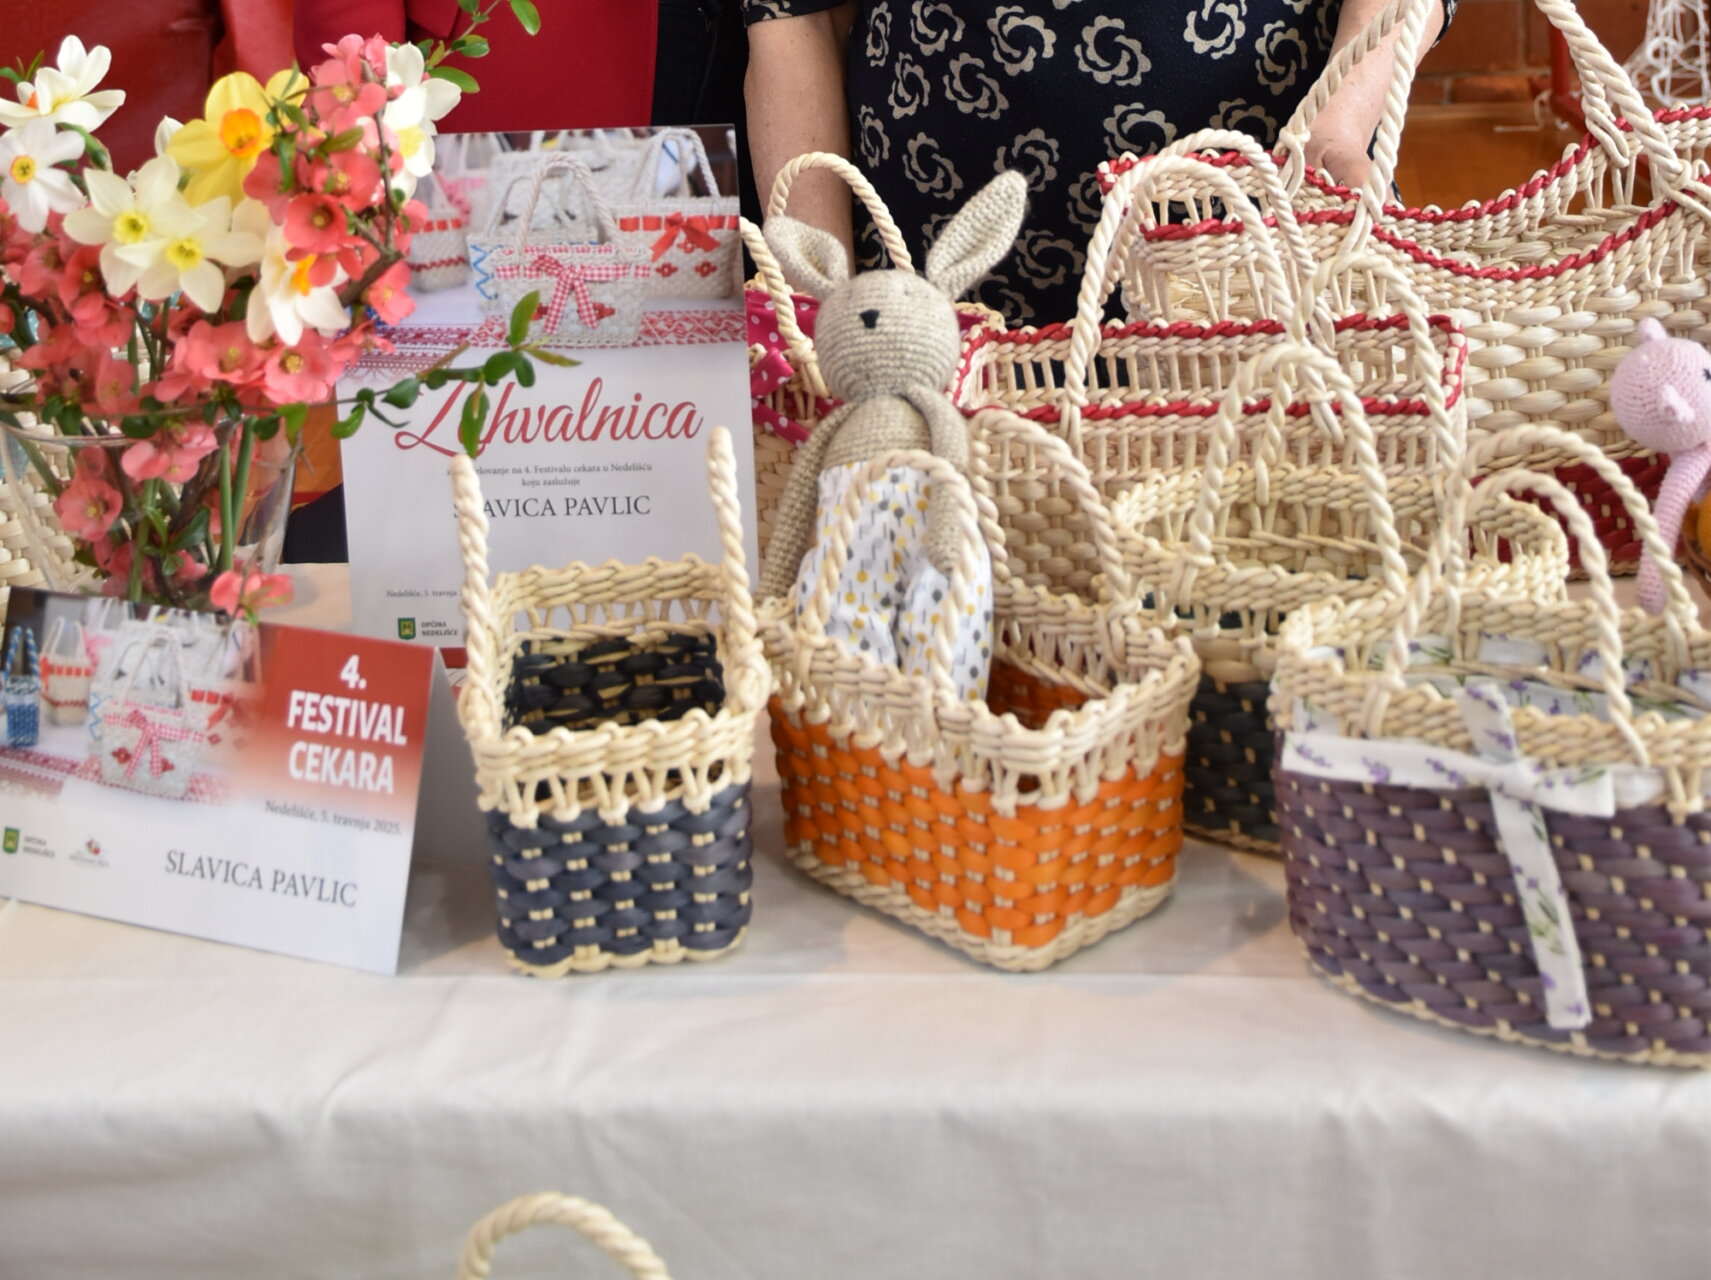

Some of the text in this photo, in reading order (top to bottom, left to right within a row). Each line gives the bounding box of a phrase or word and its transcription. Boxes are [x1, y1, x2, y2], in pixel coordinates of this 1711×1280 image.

[395, 377, 704, 458] Zhvalnica
[521, 477, 581, 488] koju zaslužuje
[534, 465, 572, 474] Festivalu
[573, 465, 601, 473] cekara
[564, 495, 652, 517] PAVLIC
[339, 654, 368, 690] 4.
[286, 690, 408, 746] FESTIVAL
[288, 740, 395, 795] CEKARA
[164, 849, 359, 908] SLAVICA PAVLIC
